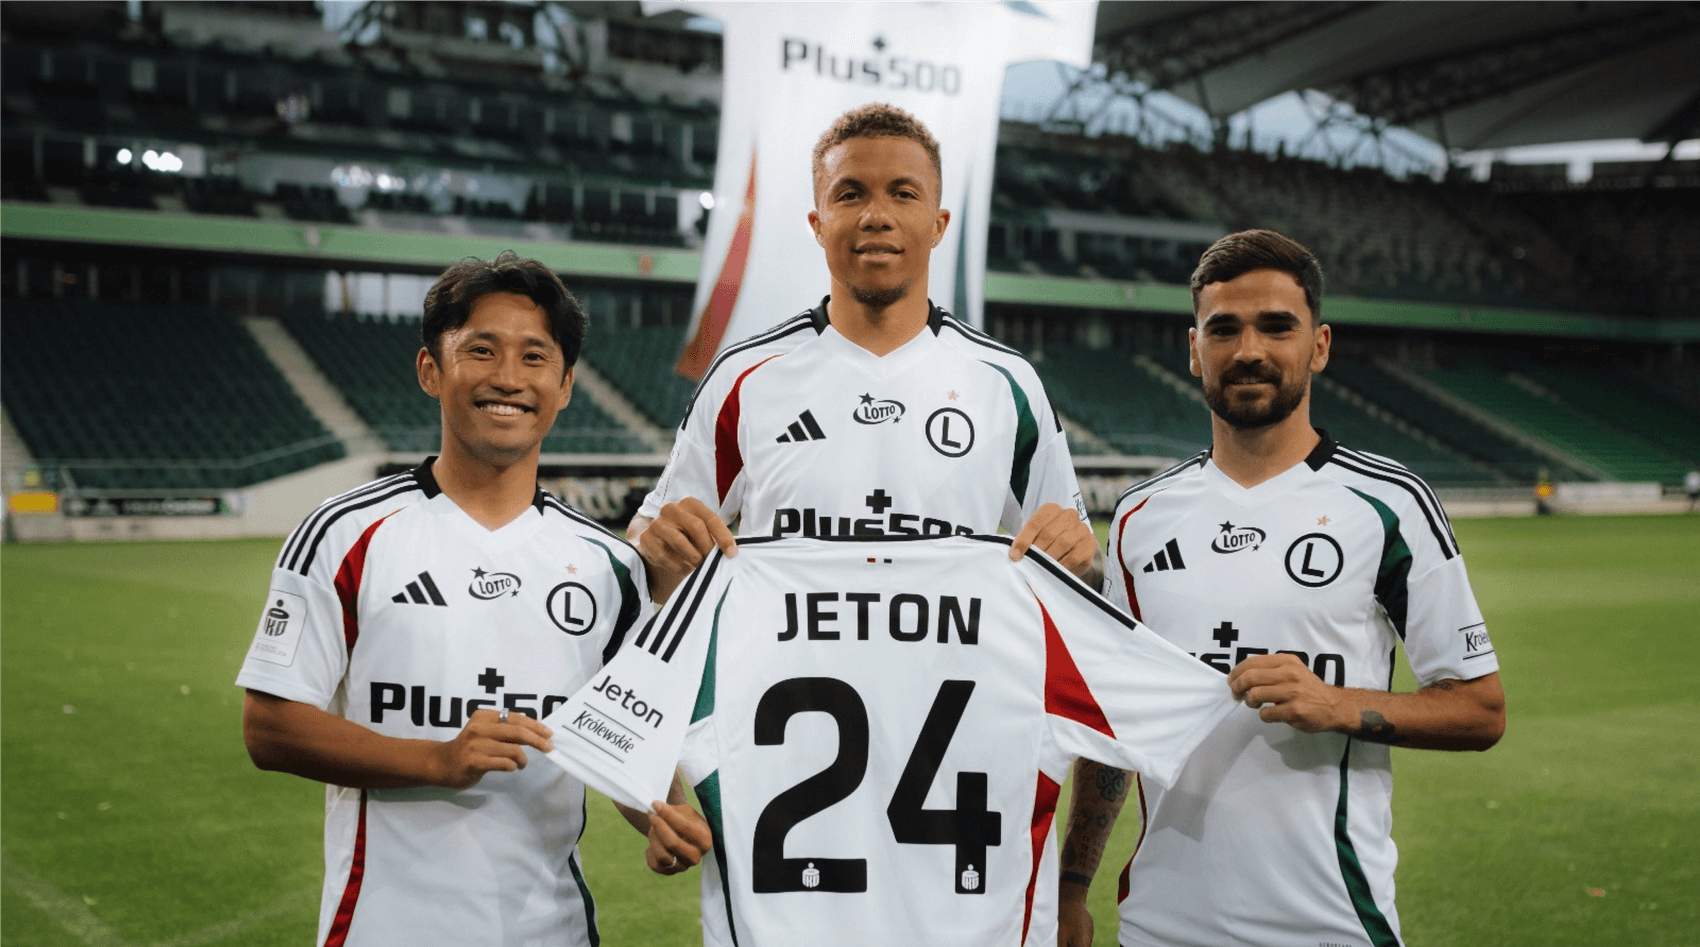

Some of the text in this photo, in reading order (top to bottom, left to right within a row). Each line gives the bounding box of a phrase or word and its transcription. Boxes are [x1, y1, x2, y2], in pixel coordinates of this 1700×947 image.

[781, 37, 962, 97] Plus500
[863, 403, 896, 420] LOTTO
[941, 416, 961, 448] L
[1222, 533, 1256, 549] LOTTO
[1301, 542, 1325, 577] L
[478, 577, 511, 595] LOTTO
[564, 591, 584, 626] L
[777, 592, 982, 645] JETON
[592, 675, 664, 729] Jeton
[572, 710, 635, 753] Królewskie
[752, 676, 1002, 894] 24
